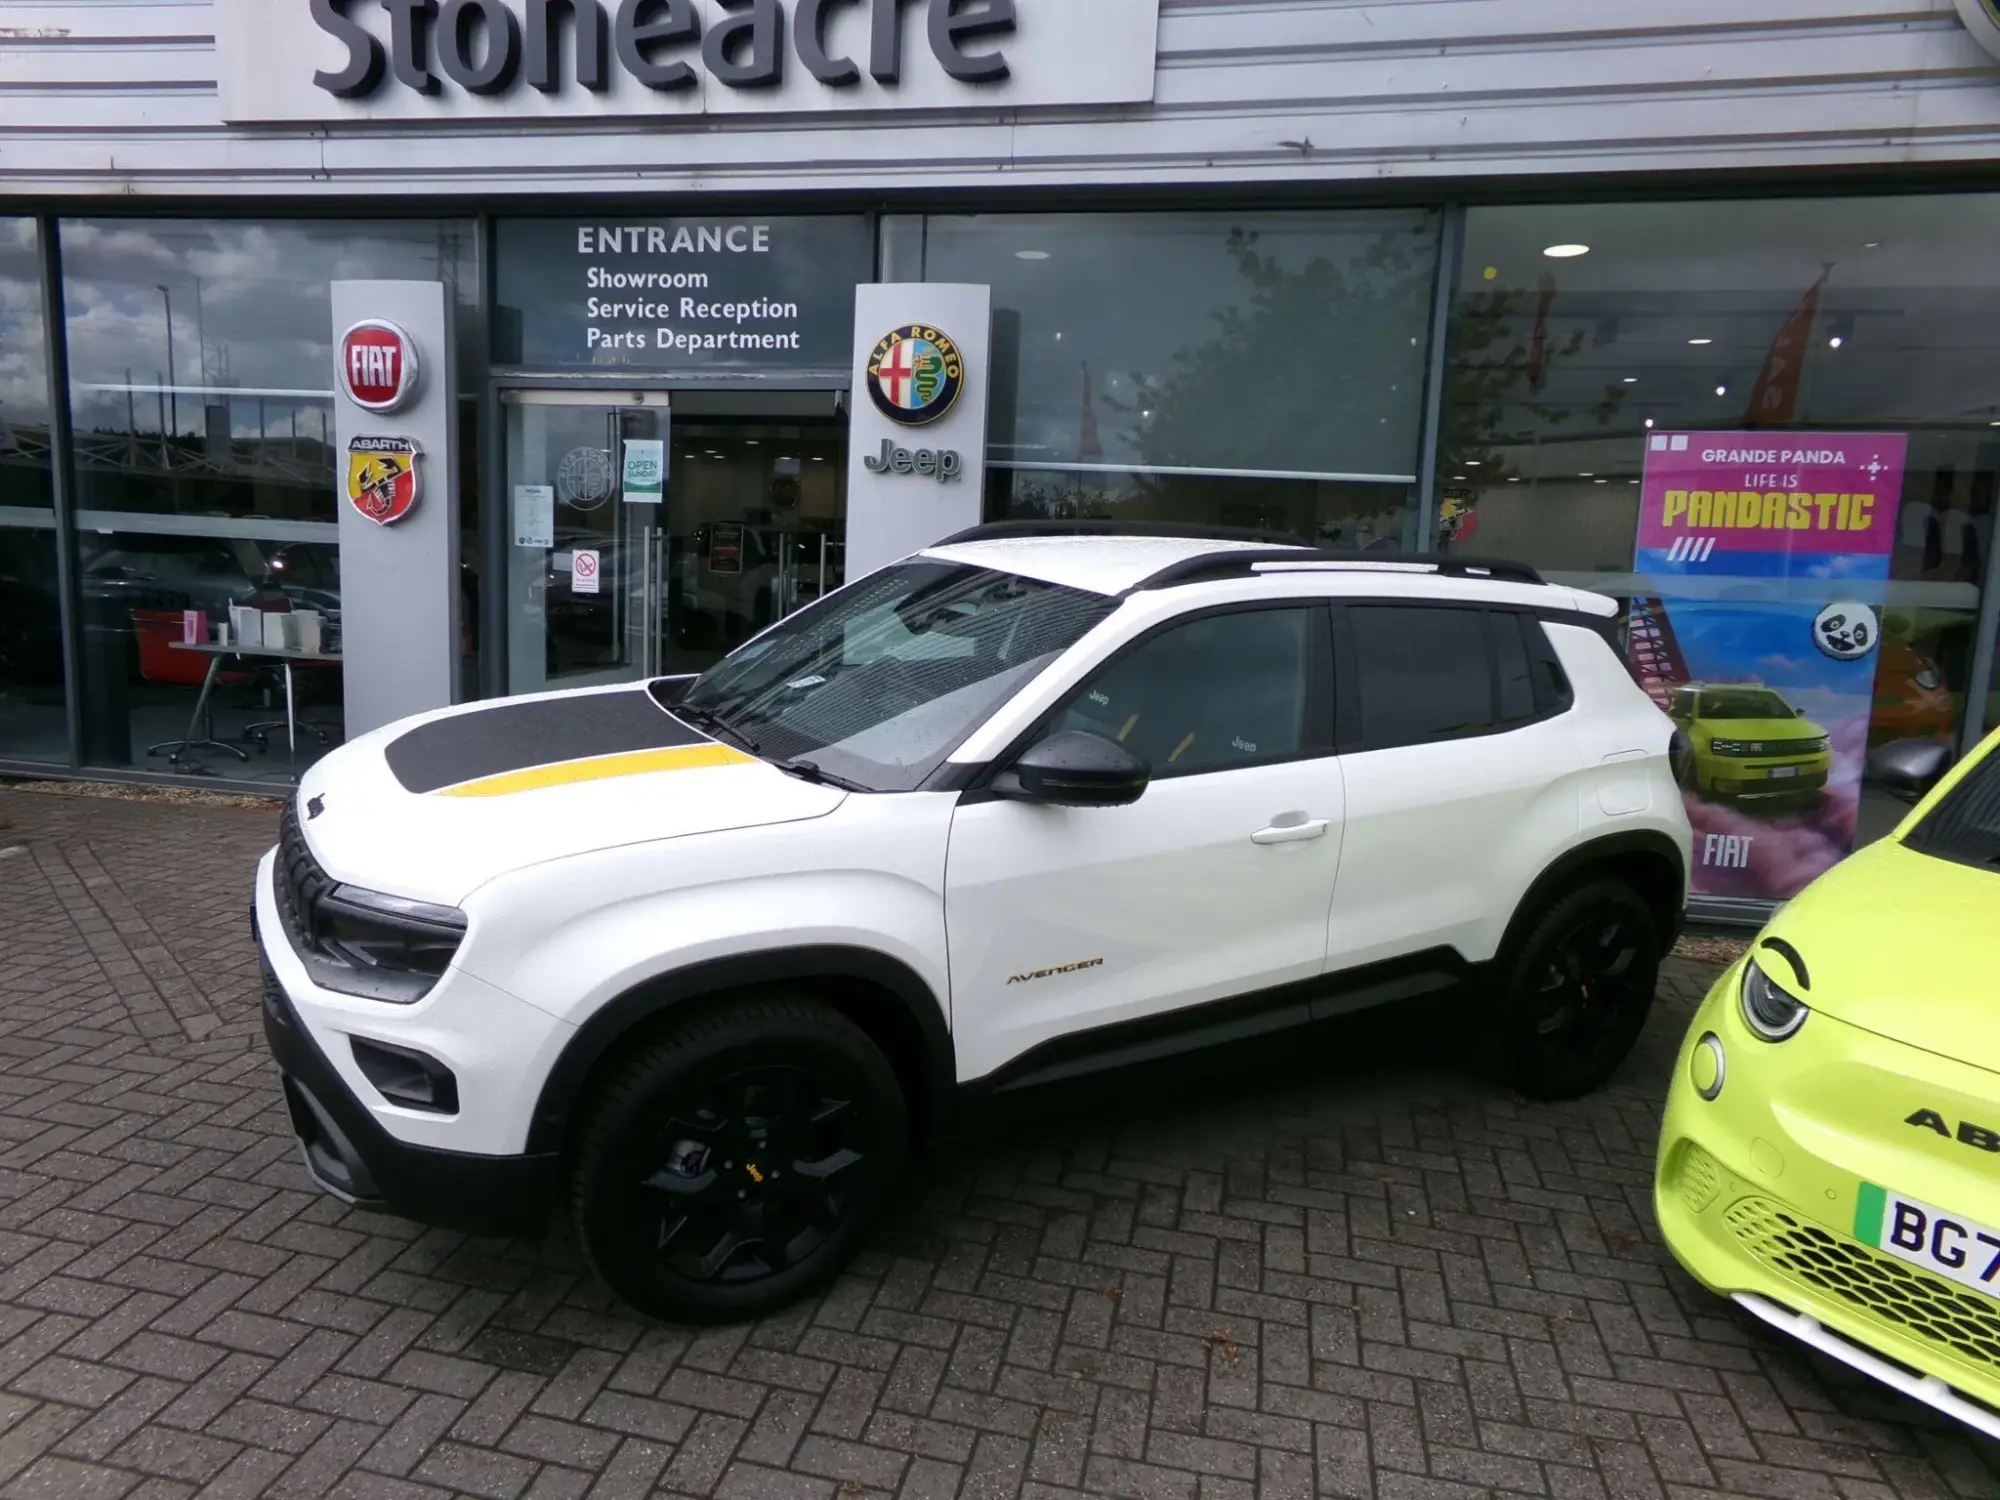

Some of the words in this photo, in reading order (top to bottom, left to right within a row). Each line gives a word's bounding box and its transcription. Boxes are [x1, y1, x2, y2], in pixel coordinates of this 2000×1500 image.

[311, 0, 1017, 98] Stoneacre
[577, 225, 770, 254] ENTRANCE
[587, 267, 709, 289] Showroom
[587, 297, 670, 319] Service
[680, 297, 798, 325] Reception
[587, 328, 646, 349] Parts
[656, 328, 800, 355] Department
[868, 332, 902, 377] ALFA
[911, 326, 960, 378] ROMEO
[351, 345, 397, 388] FIAT
[351, 438, 409, 451] ABARTH
[1702, 450, 1777, 465] GRANDE
[1780, 450, 1846, 465] PANDA
[627, 460, 658, 471] OPEN
[863, 438, 963, 483] Jeep
[1744, 473, 1777, 488] LIFE
[1782, 474, 1798, 488] IS
[1662, 490, 1876, 531] PANDASTIC
[1089, 690, 1110, 706] Jeep
[1703, 833, 1754, 868] FIAT
[1006, 957, 1104, 985] AVENGER
[746, 1163, 763, 1182] Jeep
